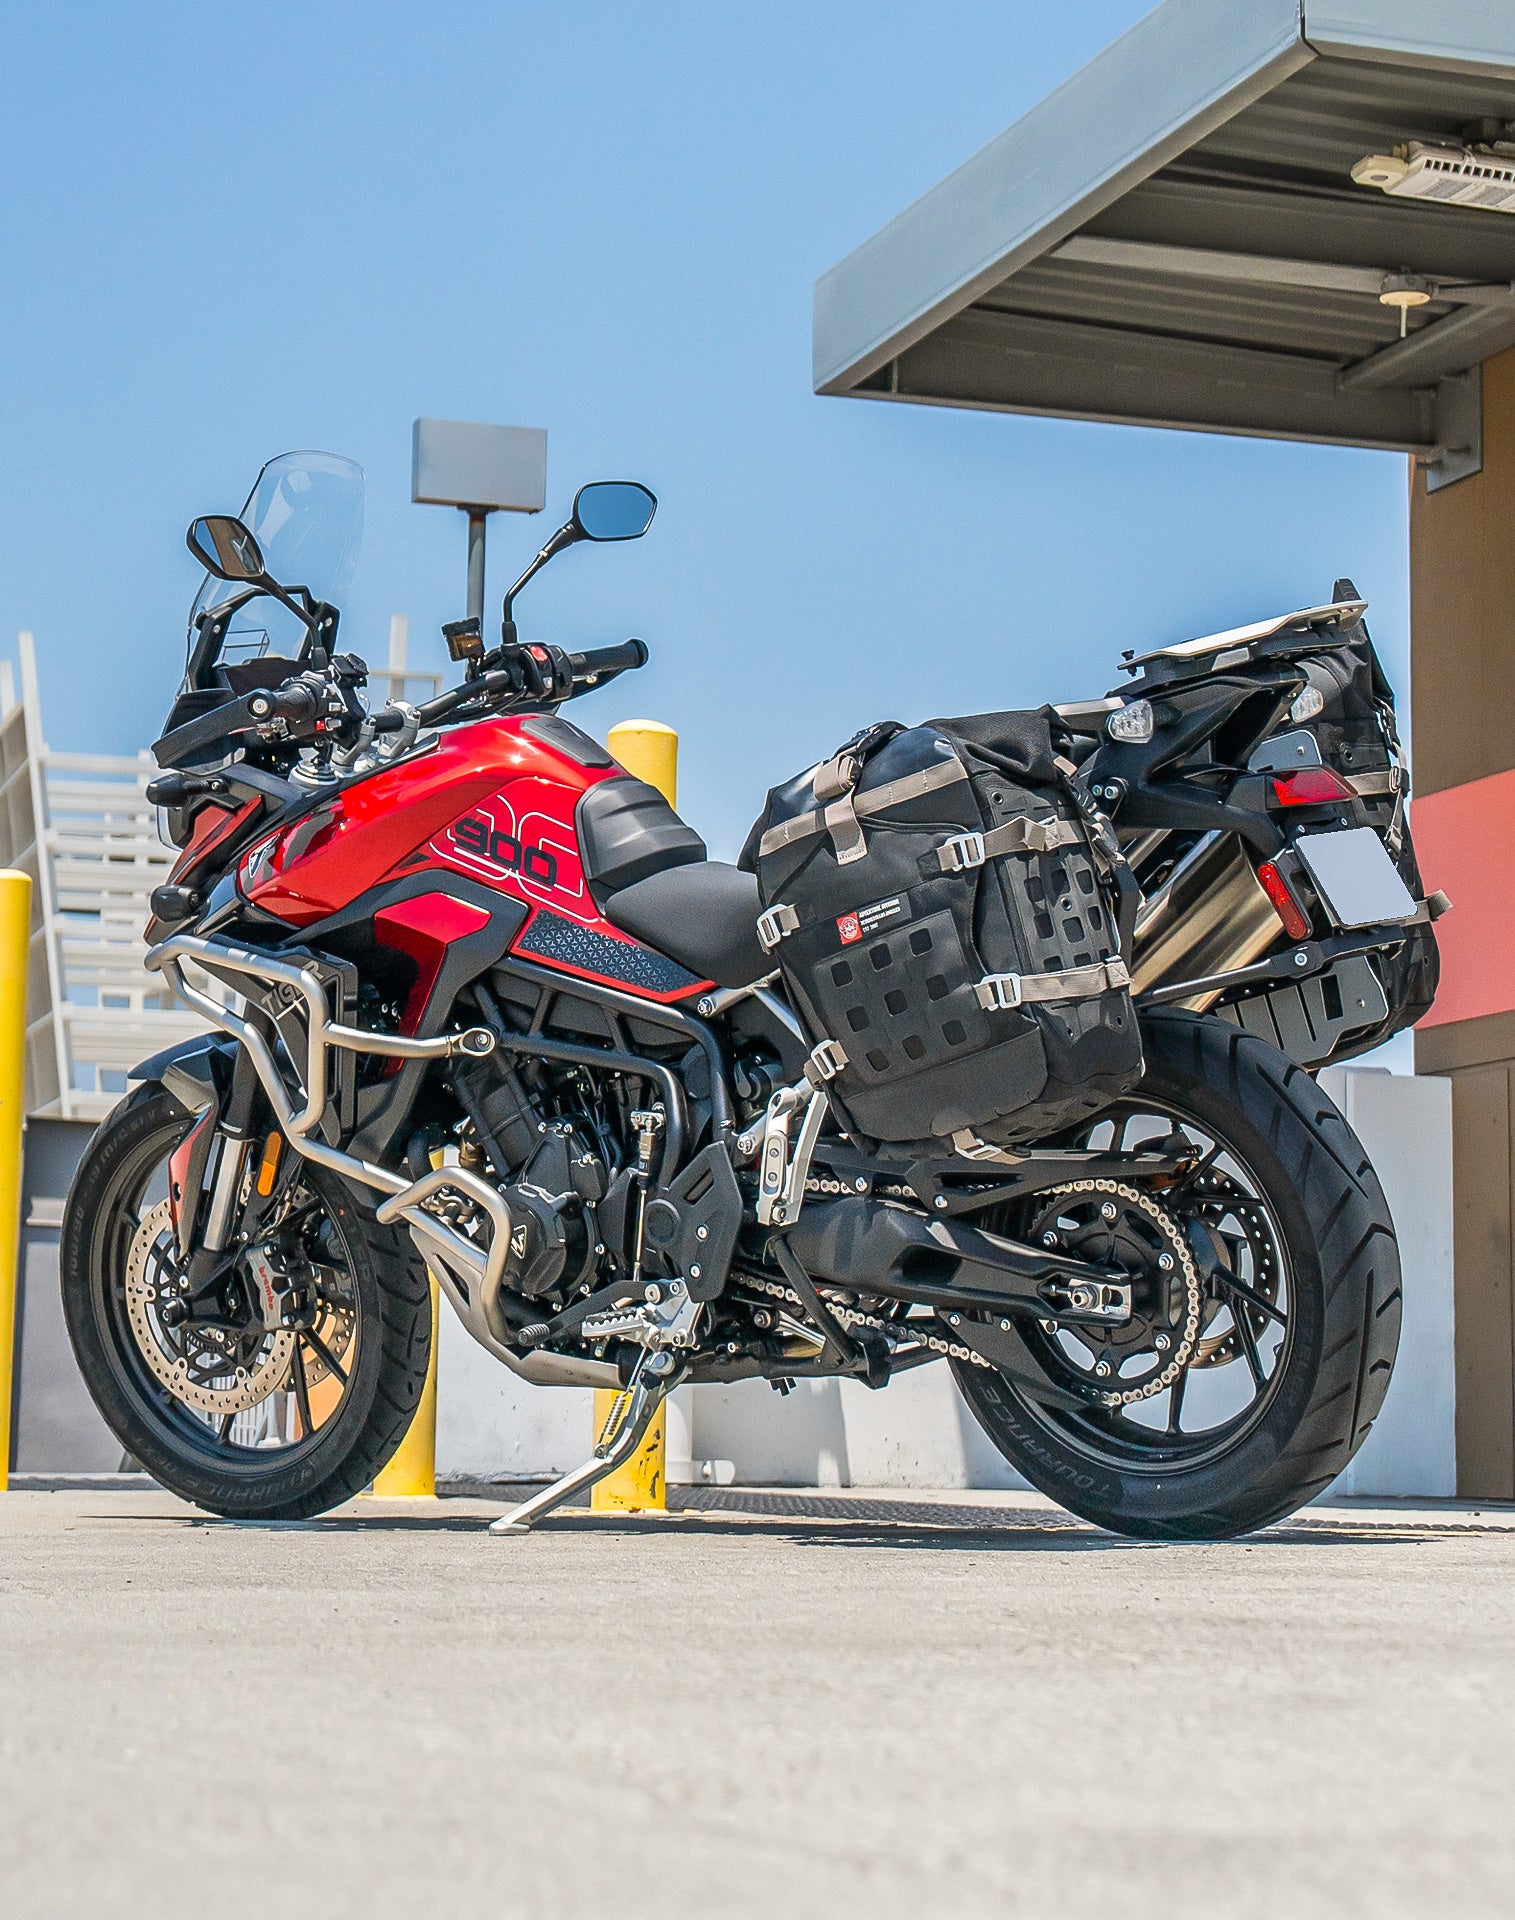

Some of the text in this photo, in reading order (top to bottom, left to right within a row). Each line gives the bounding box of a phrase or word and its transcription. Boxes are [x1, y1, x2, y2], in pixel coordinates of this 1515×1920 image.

[454, 817, 558, 886] 900
[261, 960, 324, 1016] TIGR
[258, 1266, 275, 1310] brembo
[978, 1384, 1110, 1496] TOURANCE
